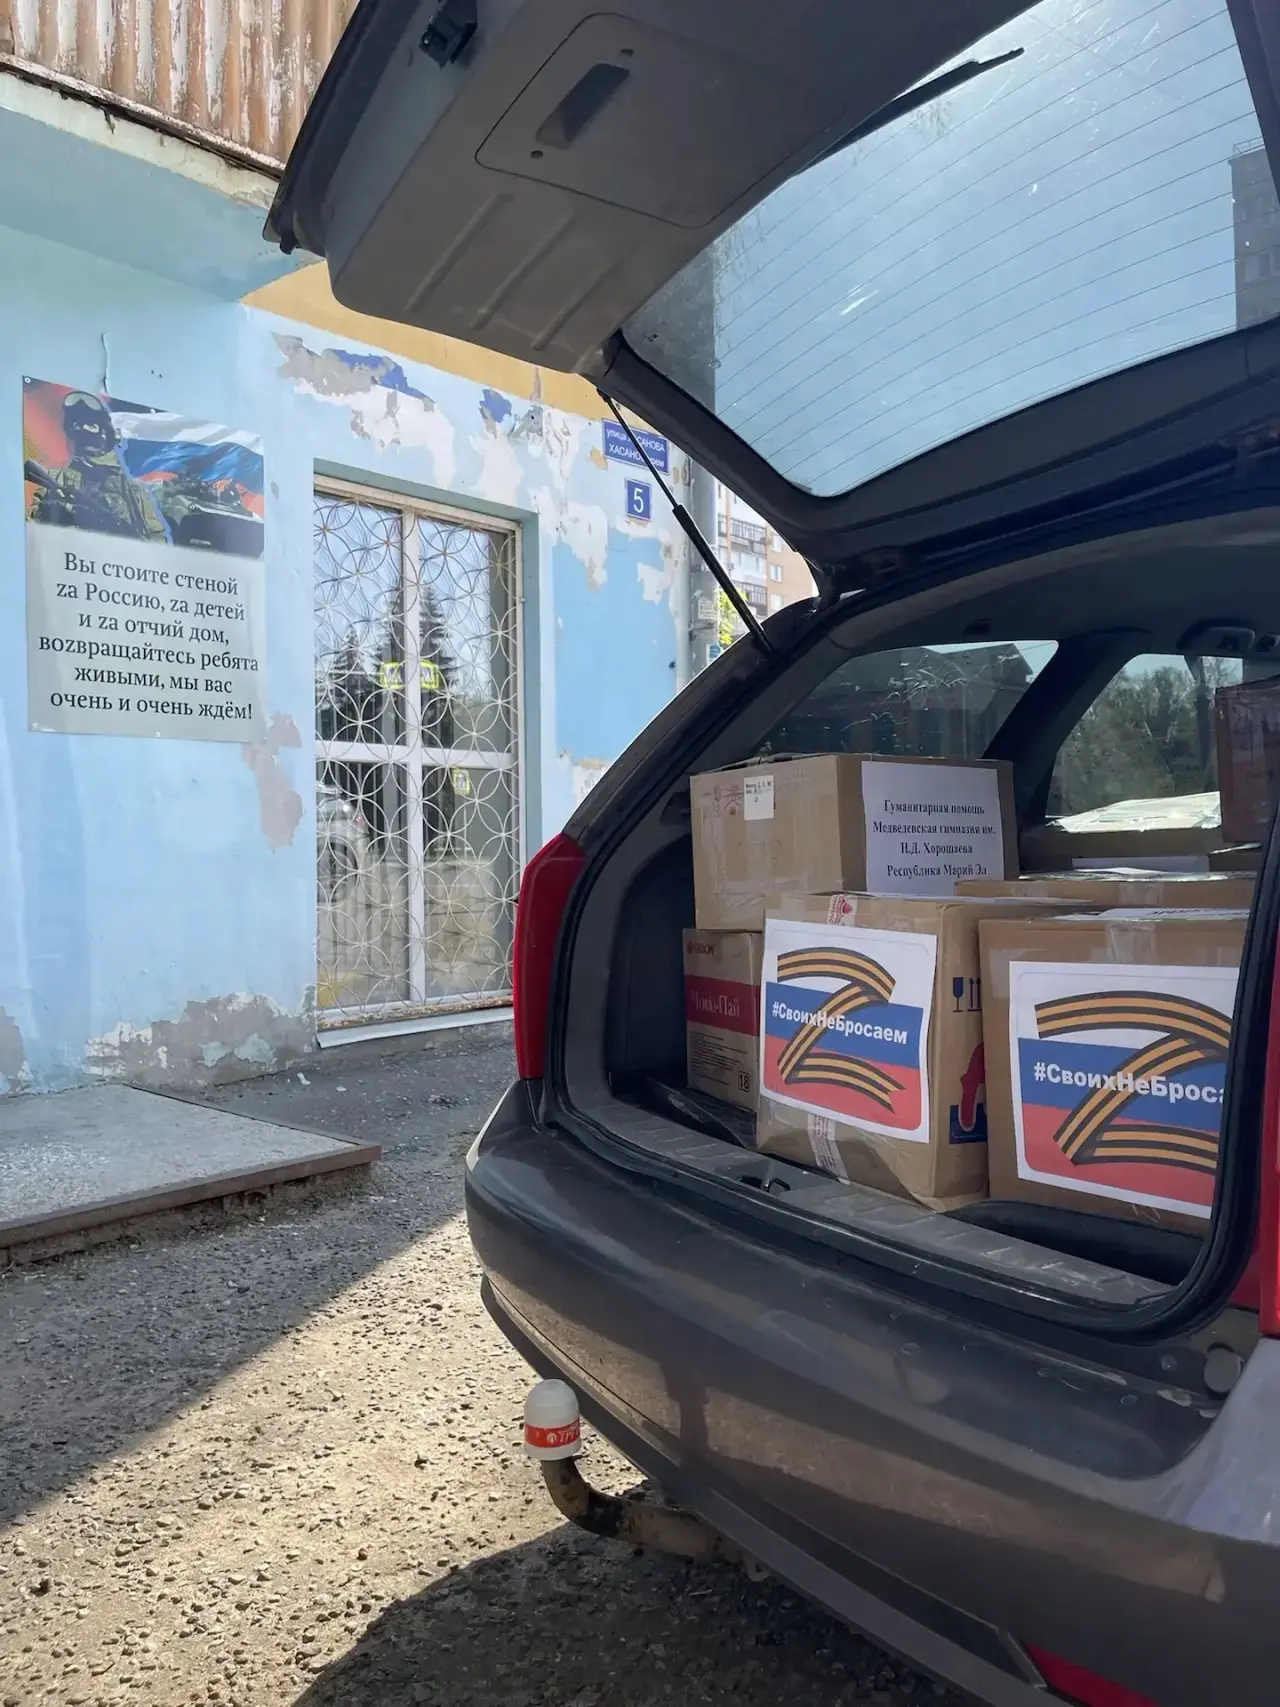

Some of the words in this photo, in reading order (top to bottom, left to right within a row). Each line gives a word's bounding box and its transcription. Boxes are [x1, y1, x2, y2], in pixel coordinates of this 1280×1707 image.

[607, 429, 626, 441] улица
[628, 437, 665, 452] САНОВА
[609, 444, 644, 462] ХАСАНО
[634, 488, 643, 513] 5
[63, 552, 95, 575] Вы
[102, 562, 169, 584] стоите
[175, 570, 238, 595] стеной
[85, 583, 165, 612] Россию,
[194, 599, 245, 622] детей
[79, 613, 91, 628] и
[125, 616, 183, 638] отчий
[189, 624, 229, 646] дом,
[200, 651, 259, 672] ребята
[74, 666, 165, 691] живыми,
[170, 676, 199, 691] мы
[204, 677, 232, 693] вас
[51, 693, 112, 711] очень
[119, 698, 131, 712] и
[137, 698, 193, 716] очень
[198, 701, 252, 720] ждём!
[884, 800, 948, 815] Гуманитарная
[951, 805, 984, 814] помощь
[873, 821, 937, 834] Медведевская
[940, 825, 980, 834] гимназия
[982, 826, 996, 835] им.
[900, 842, 920, 855] Н.Д.
[887, 865, 941, 879] Республика
[944, 864, 973, 878] Марий
[976, 864, 987, 875] Эл
[772, 1001, 908, 1044] #СвоихНеБросаем
[739, 1073, 749, 1090] 18
